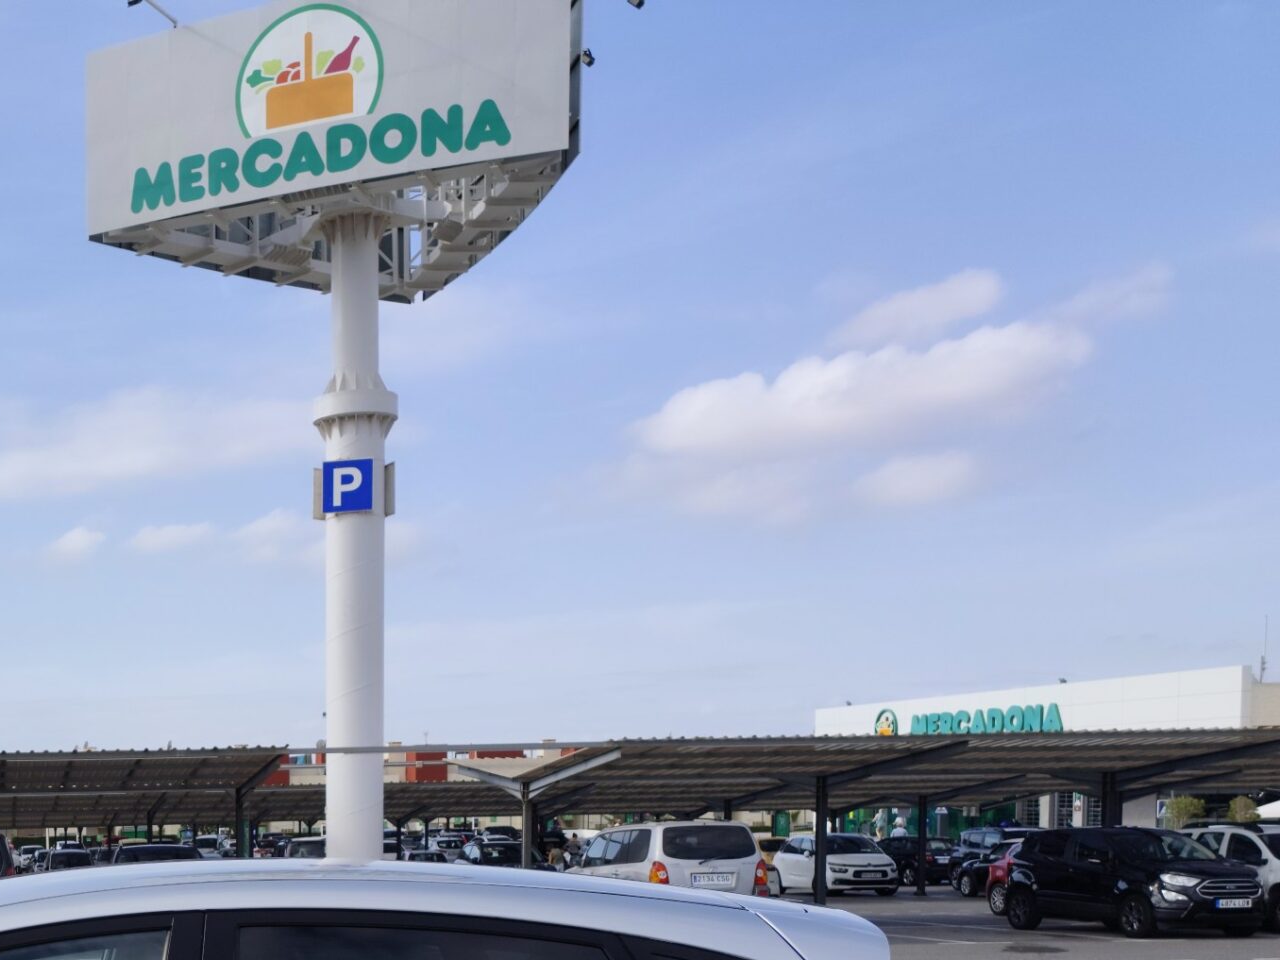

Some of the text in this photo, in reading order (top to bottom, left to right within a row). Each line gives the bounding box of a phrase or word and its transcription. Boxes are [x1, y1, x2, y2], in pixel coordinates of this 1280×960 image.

[130, 99, 512, 213] MERCADONA
[332, 466, 363, 507] P
[911, 703, 1063, 735] MERCADONA
